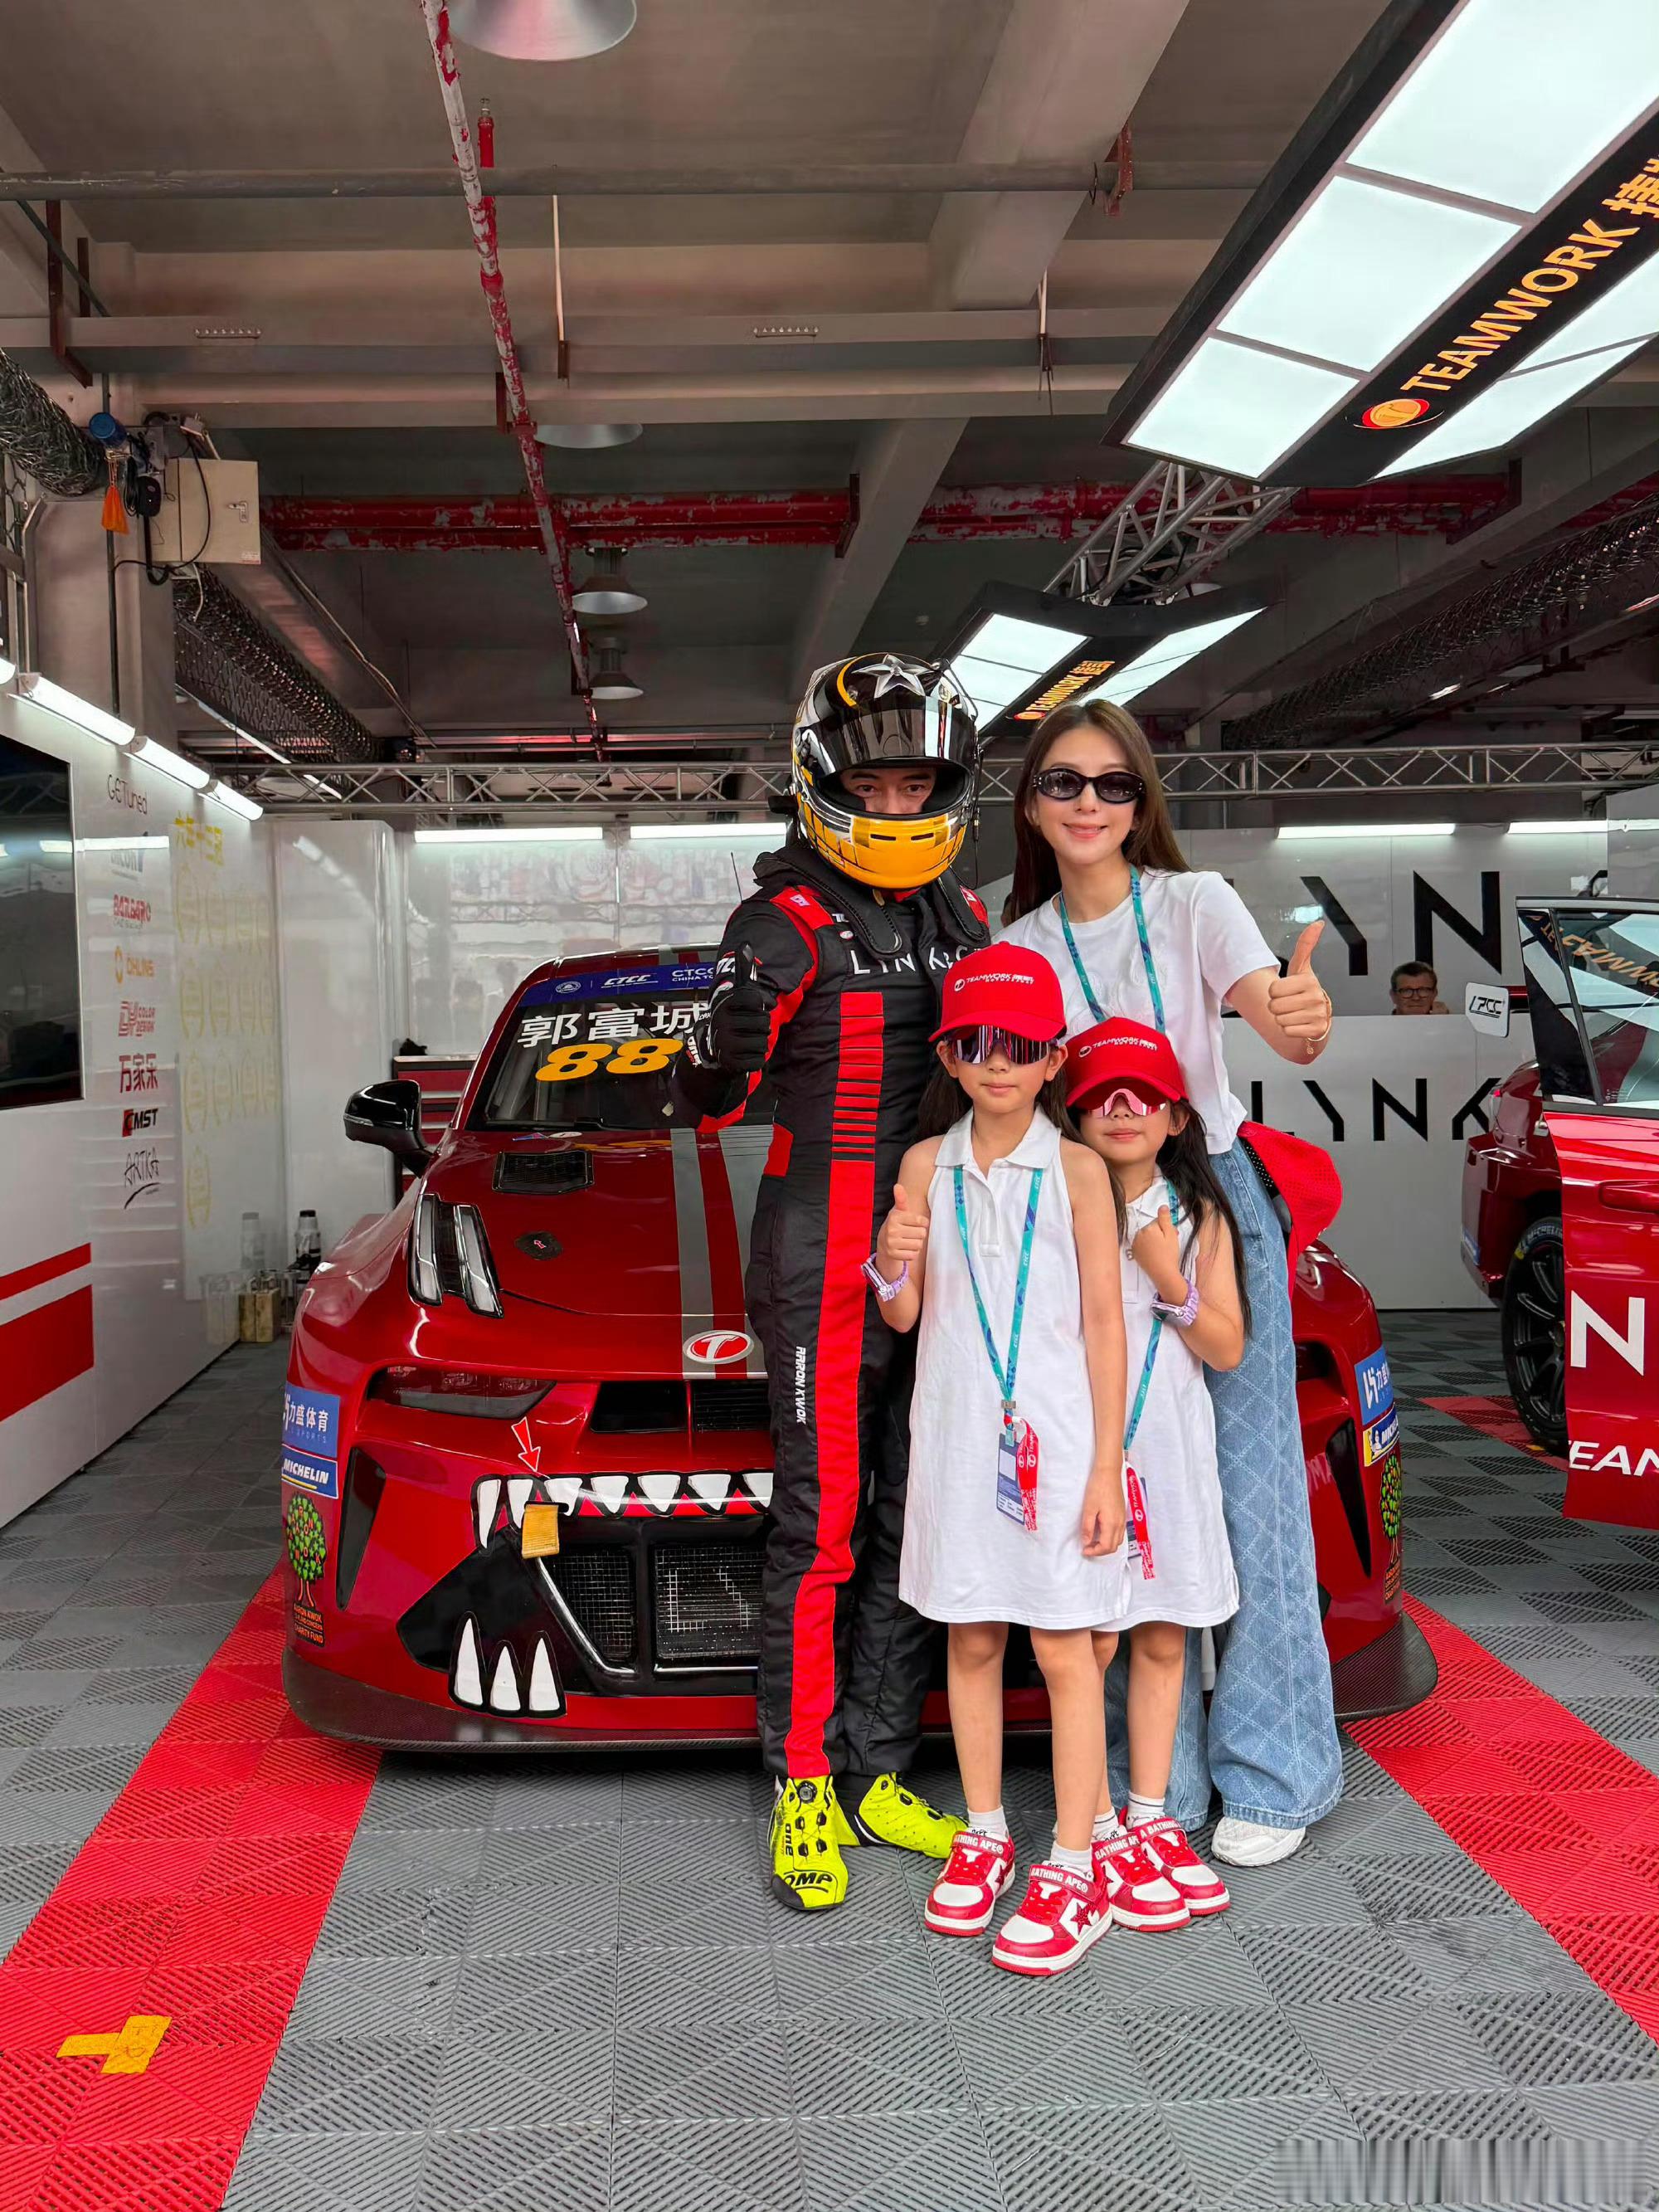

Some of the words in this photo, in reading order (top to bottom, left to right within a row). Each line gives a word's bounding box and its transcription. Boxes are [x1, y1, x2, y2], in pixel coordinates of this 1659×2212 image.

[1400, 218, 1640, 391] TEAMWORK
[1025, 674, 1093, 711] TEAMWORK
[604, 974, 651, 987] CTCC
[119, 1053, 158, 1094] 万家乐
[535, 1038, 684, 1081] 88
[795, 1346, 806, 1387] AARON
[795, 1388, 806, 1425] KWOK
[283, 1459, 329, 1484] MICHELIN
